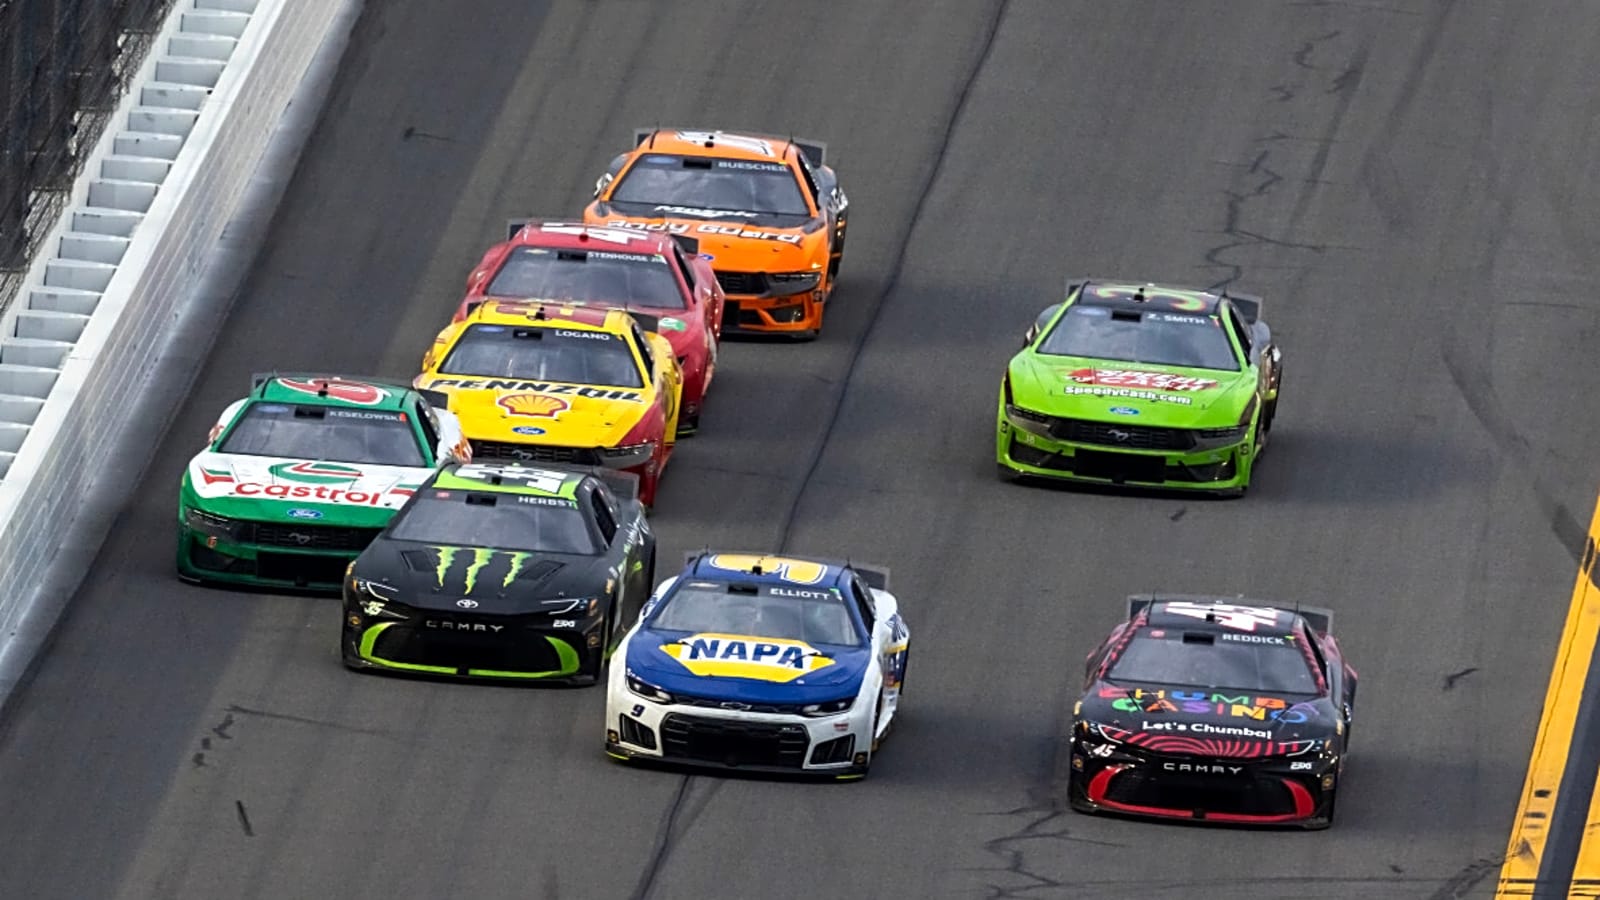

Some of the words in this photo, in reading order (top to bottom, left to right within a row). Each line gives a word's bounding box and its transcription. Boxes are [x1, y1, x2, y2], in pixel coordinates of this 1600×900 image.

[697, 223, 801, 243] Guard
[1147, 313, 1161, 322] Z.
[1163, 315, 1206, 325] SMITH
[555, 329, 610, 341] LOGANO
[428, 378, 643, 403] PENNZOIL
[1064, 386, 1192, 405] SpeedyCash.com
[235, 482, 382, 506] Castrol
[770, 587, 830, 600] ELLIOTT
[426, 619, 504, 632] CAMRY
[1222, 633, 1286, 646] REDDICK
[688, 638, 804, 669] NAPA
[630, 704, 646, 717] 9
[1142, 720, 1187, 732] Let's
[1190, 722, 1272, 740] Chumba!
[1093, 743, 1117, 758] 45
[1163, 761, 1243, 775] CAMRY
